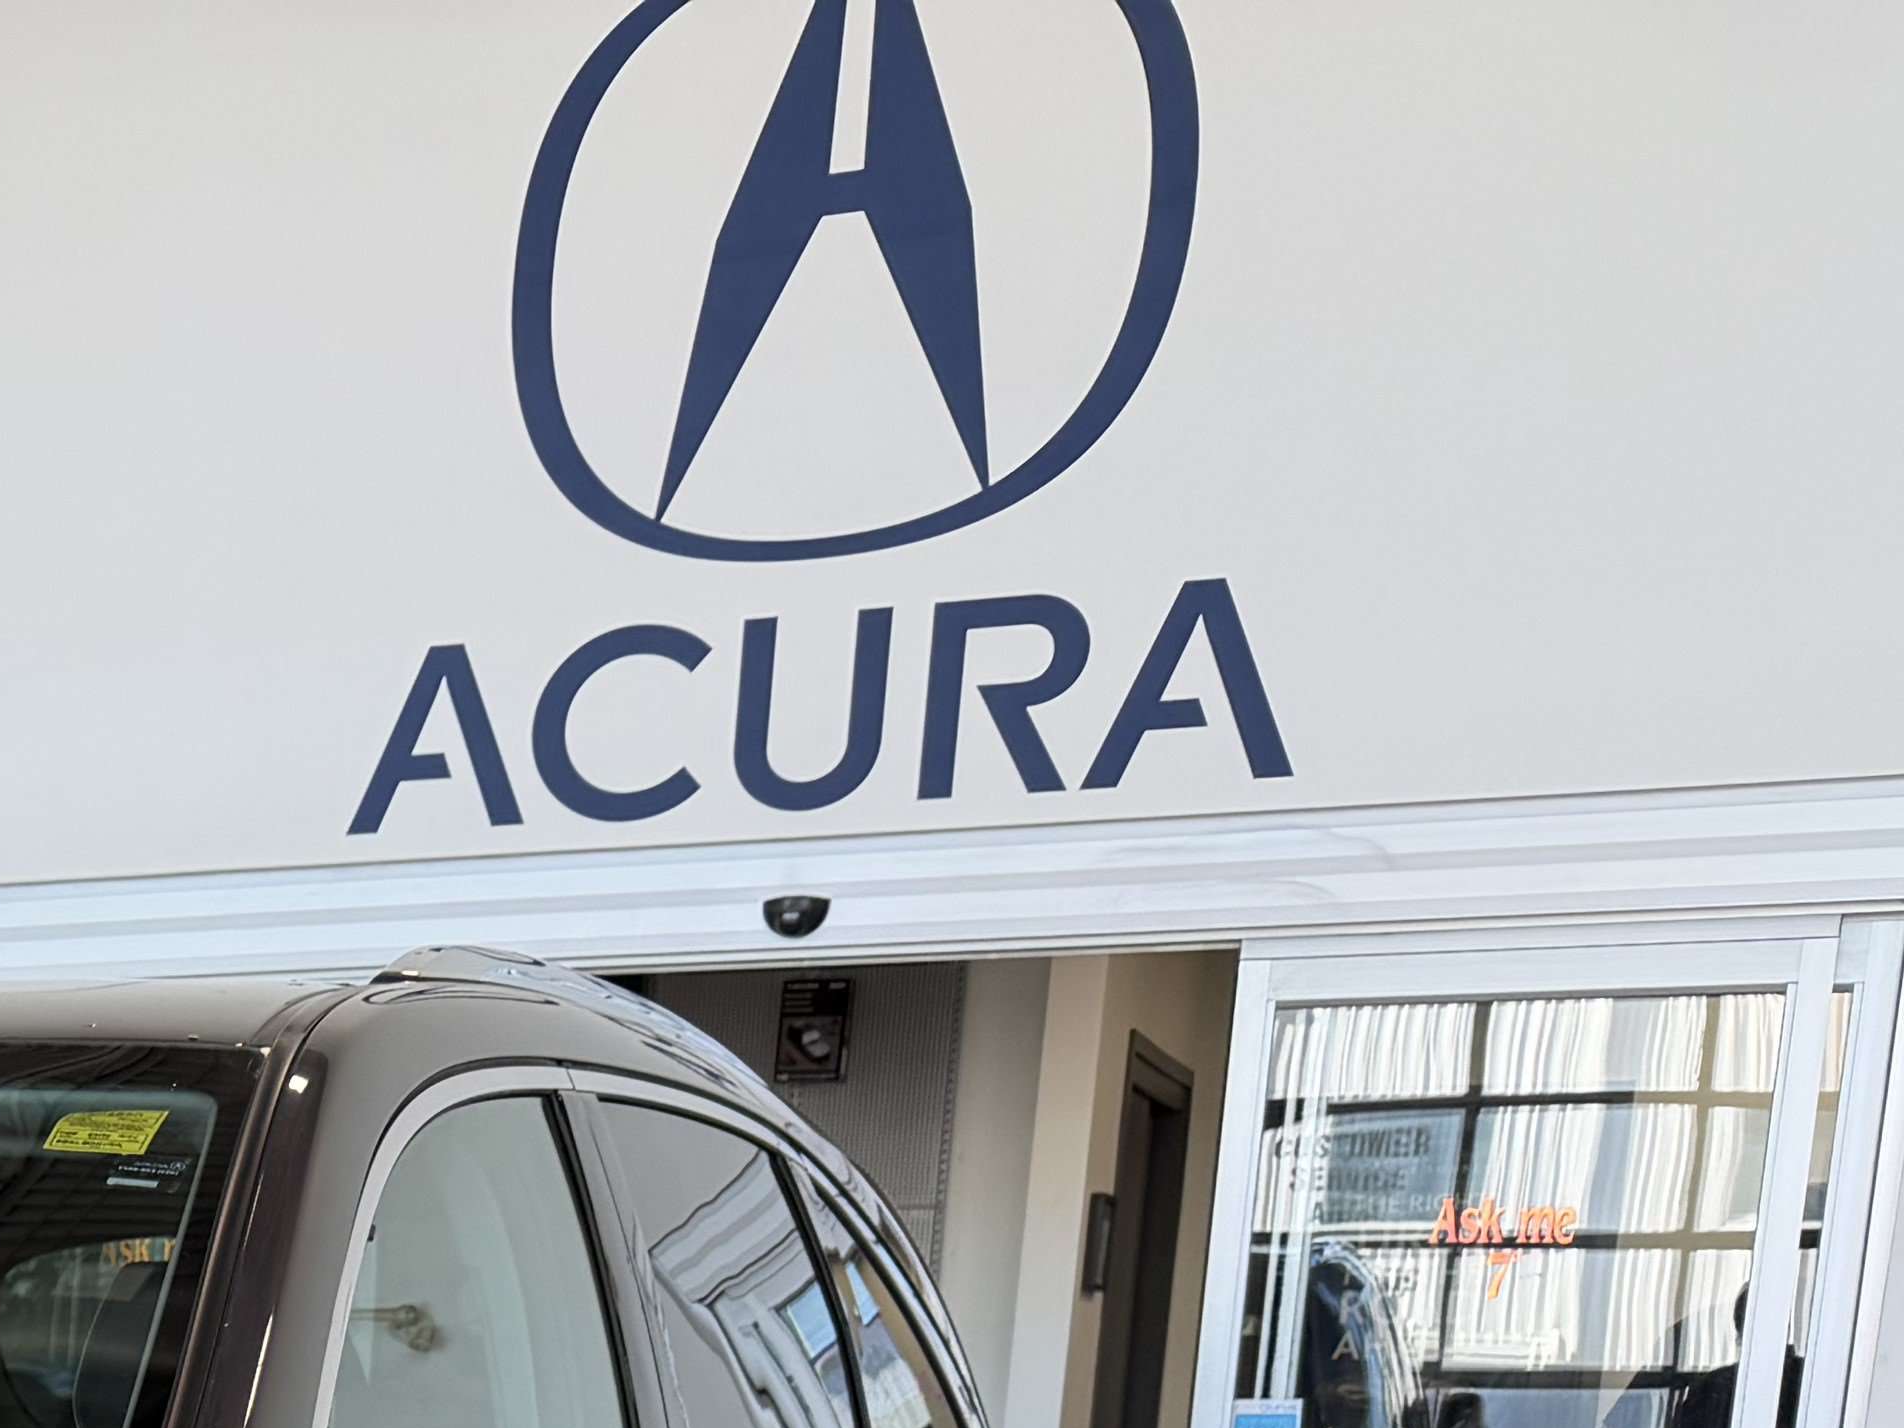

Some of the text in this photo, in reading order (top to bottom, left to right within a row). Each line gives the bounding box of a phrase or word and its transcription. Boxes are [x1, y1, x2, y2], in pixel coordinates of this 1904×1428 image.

[346, 577, 1294, 836] ACURA
[1427, 1193, 1577, 1246] Ask me
